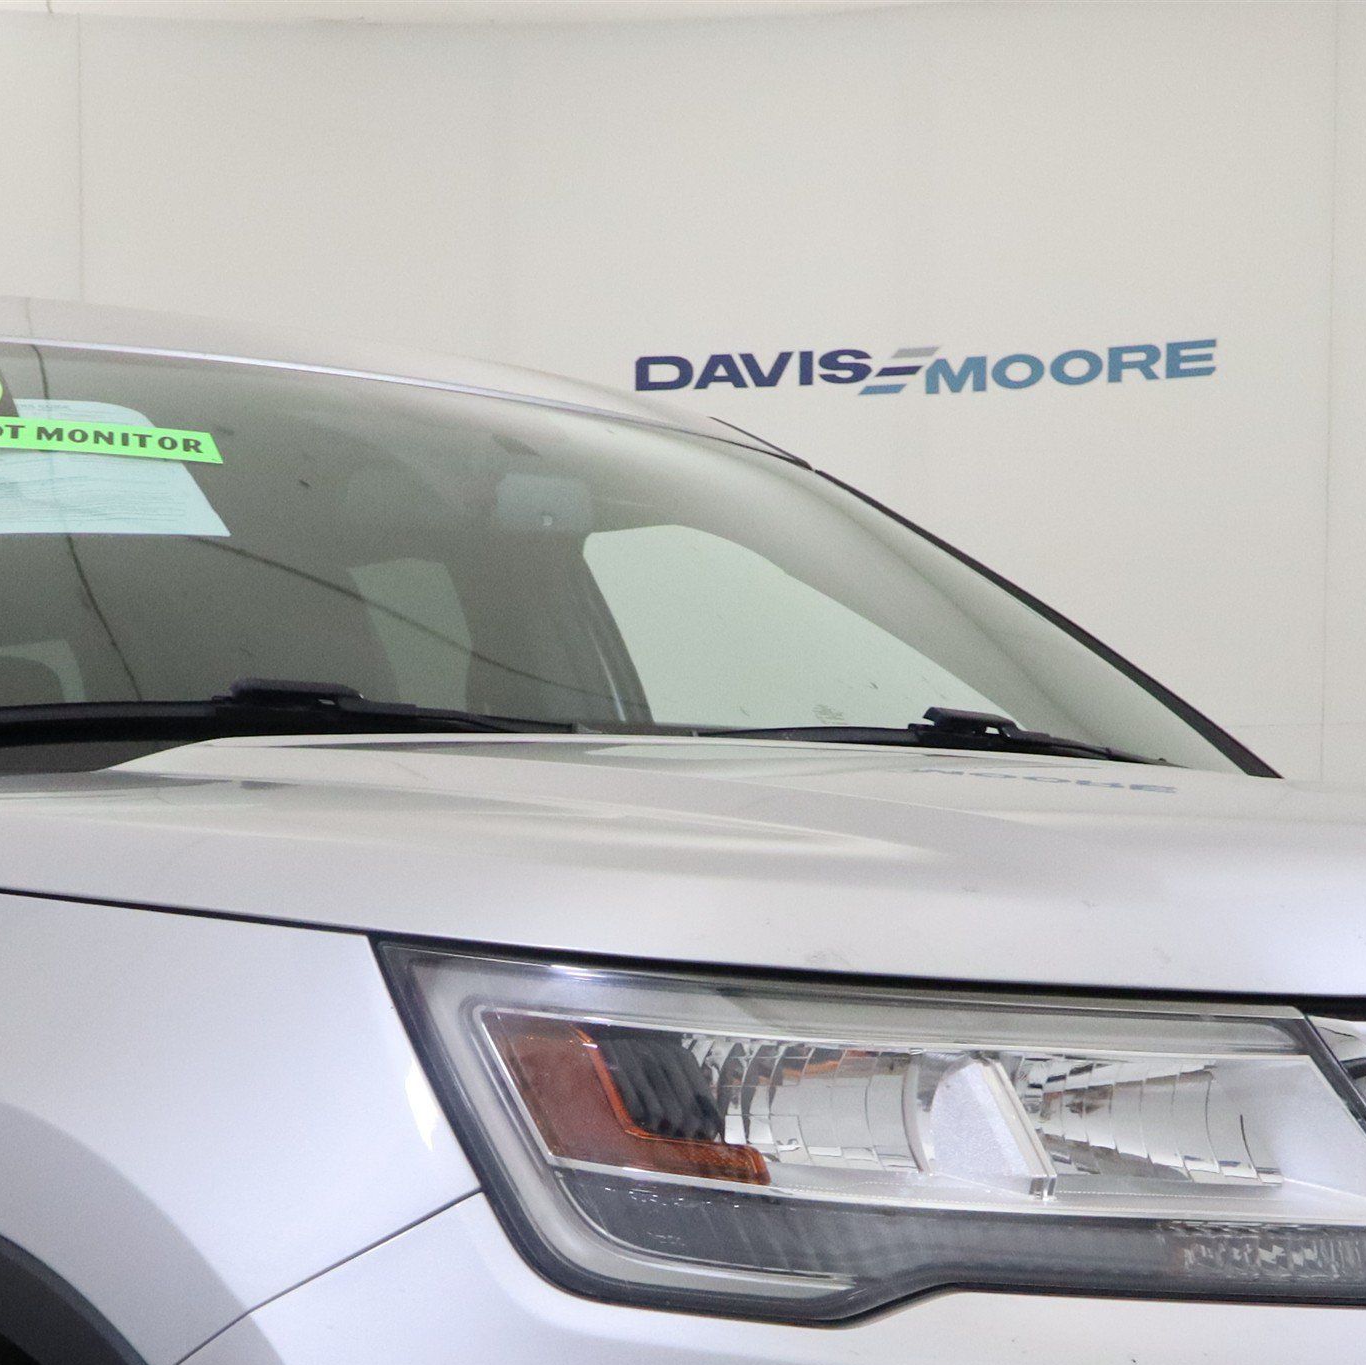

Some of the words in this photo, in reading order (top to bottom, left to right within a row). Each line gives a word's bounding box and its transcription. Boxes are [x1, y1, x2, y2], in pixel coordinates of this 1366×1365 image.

[635, 348, 873, 392] DAVIS
[925, 339, 1218, 395] MOORE
[36, 425, 204, 455] MONITOR
